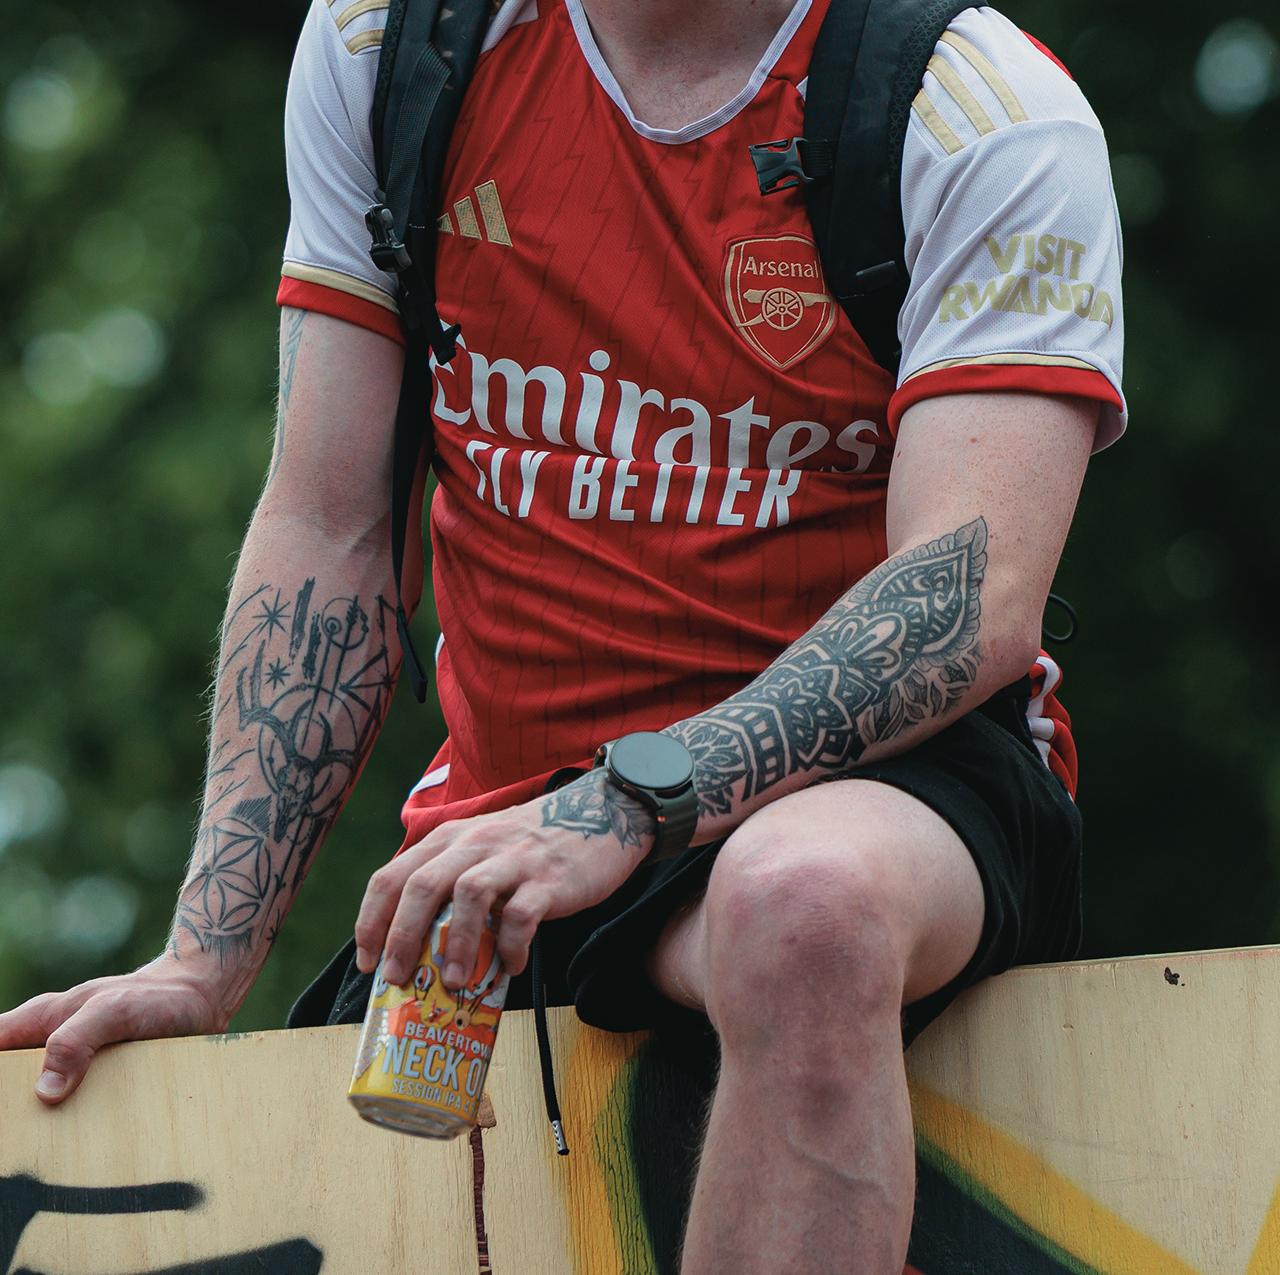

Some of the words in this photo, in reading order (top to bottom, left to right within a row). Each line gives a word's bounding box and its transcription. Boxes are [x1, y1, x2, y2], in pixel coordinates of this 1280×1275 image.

[743, 256, 819, 278] Arsenal
[984, 234, 1087, 280] VISIT
[939, 274, 1114, 331] RWANDA
[405, 1021, 491, 1060] BEAVERTOW
[381, 1035, 465, 1091] NECK
[391, 1078, 442, 1103] SESSION
[444, 1091, 462, 1109] IPA
